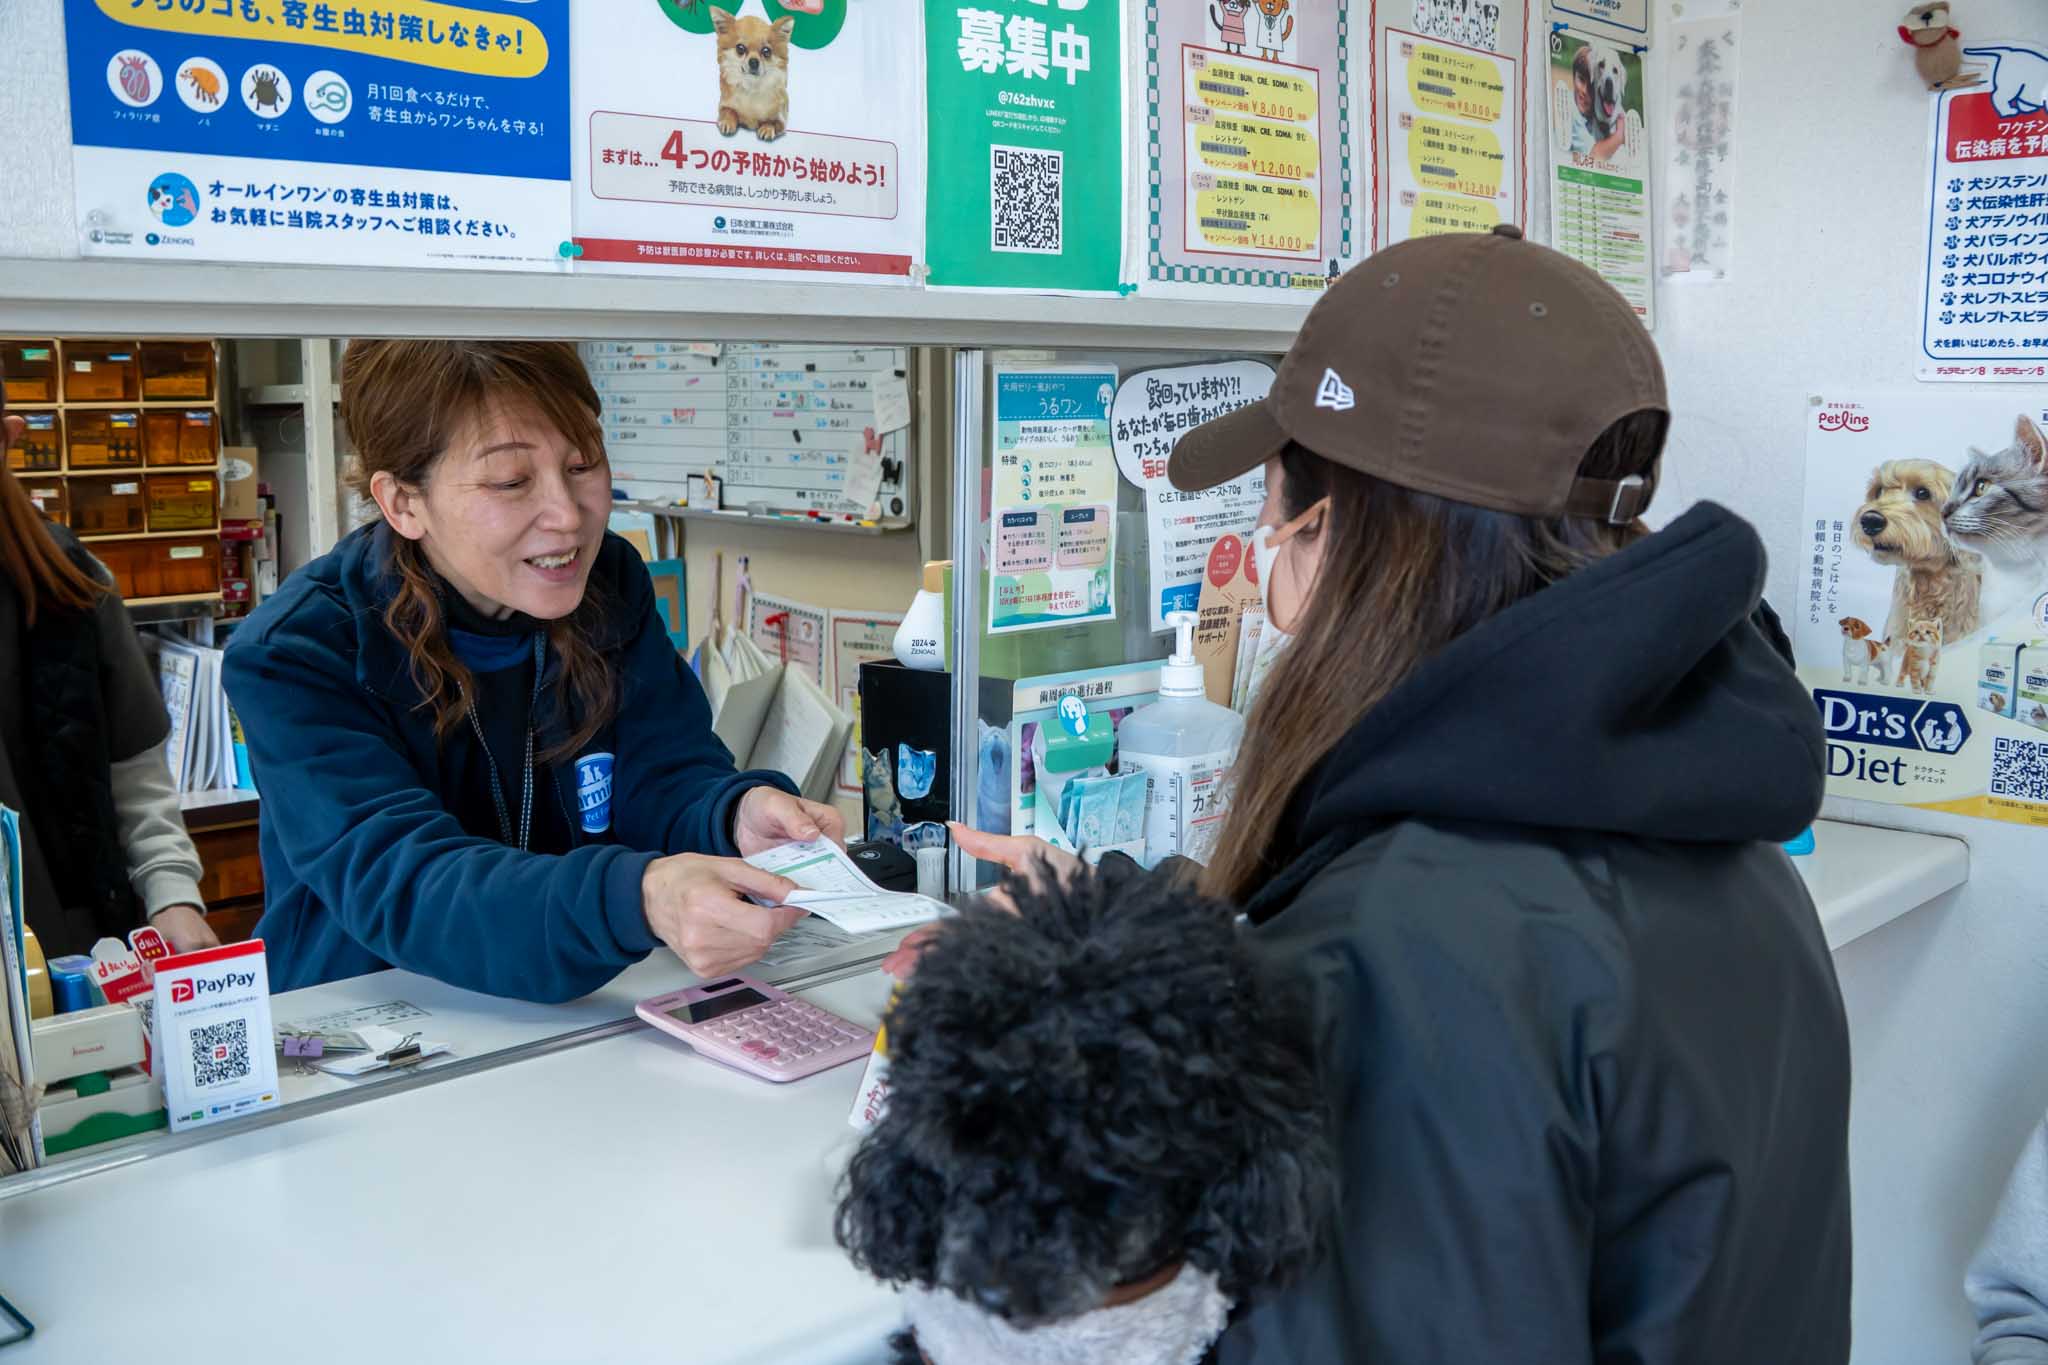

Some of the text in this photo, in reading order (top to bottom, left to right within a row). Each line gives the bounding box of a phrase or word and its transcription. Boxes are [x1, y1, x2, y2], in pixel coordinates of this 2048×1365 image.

[131, 0, 523, 55] のコも、寄生虫対策しなきゃ!
[957, 8, 1091, 85] 募集中
[368, 84, 490, 110] 月1回食べるだけで、
[998, 91, 1055, 109] @762zhvxc
[113, 111, 161, 123] フィラリア症
[368, 106, 544, 136] 寄生虫からワンちゃんを守る!
[669, 180, 837, 204] 予防できる病気は、しっかり予防しましょう。
[1967, 192, 2048, 210] 犬伝染性肝
[211, 207, 516, 239] お気軽に当院スタッフへご相談ください。
[1039, 397, 1082, 415] うるワン
[1819, 411, 1869, 432] Petline
[1001, 455, 1018, 465] 特徴
[1142, 458, 1168, 480] 毎日
[1810, 520, 1826, 624] 信頼の動物病院から
[1827, 520, 1844, 613] 毎日の「ごはん」を
[912, 639, 928, 648] 2024
[1826, 743, 1907, 786] Diet
[1914, 765, 1947, 775] ドクターズ
[1913, 775, 1945, 784] ダイエット
[197, 972, 255, 994] PayPay
